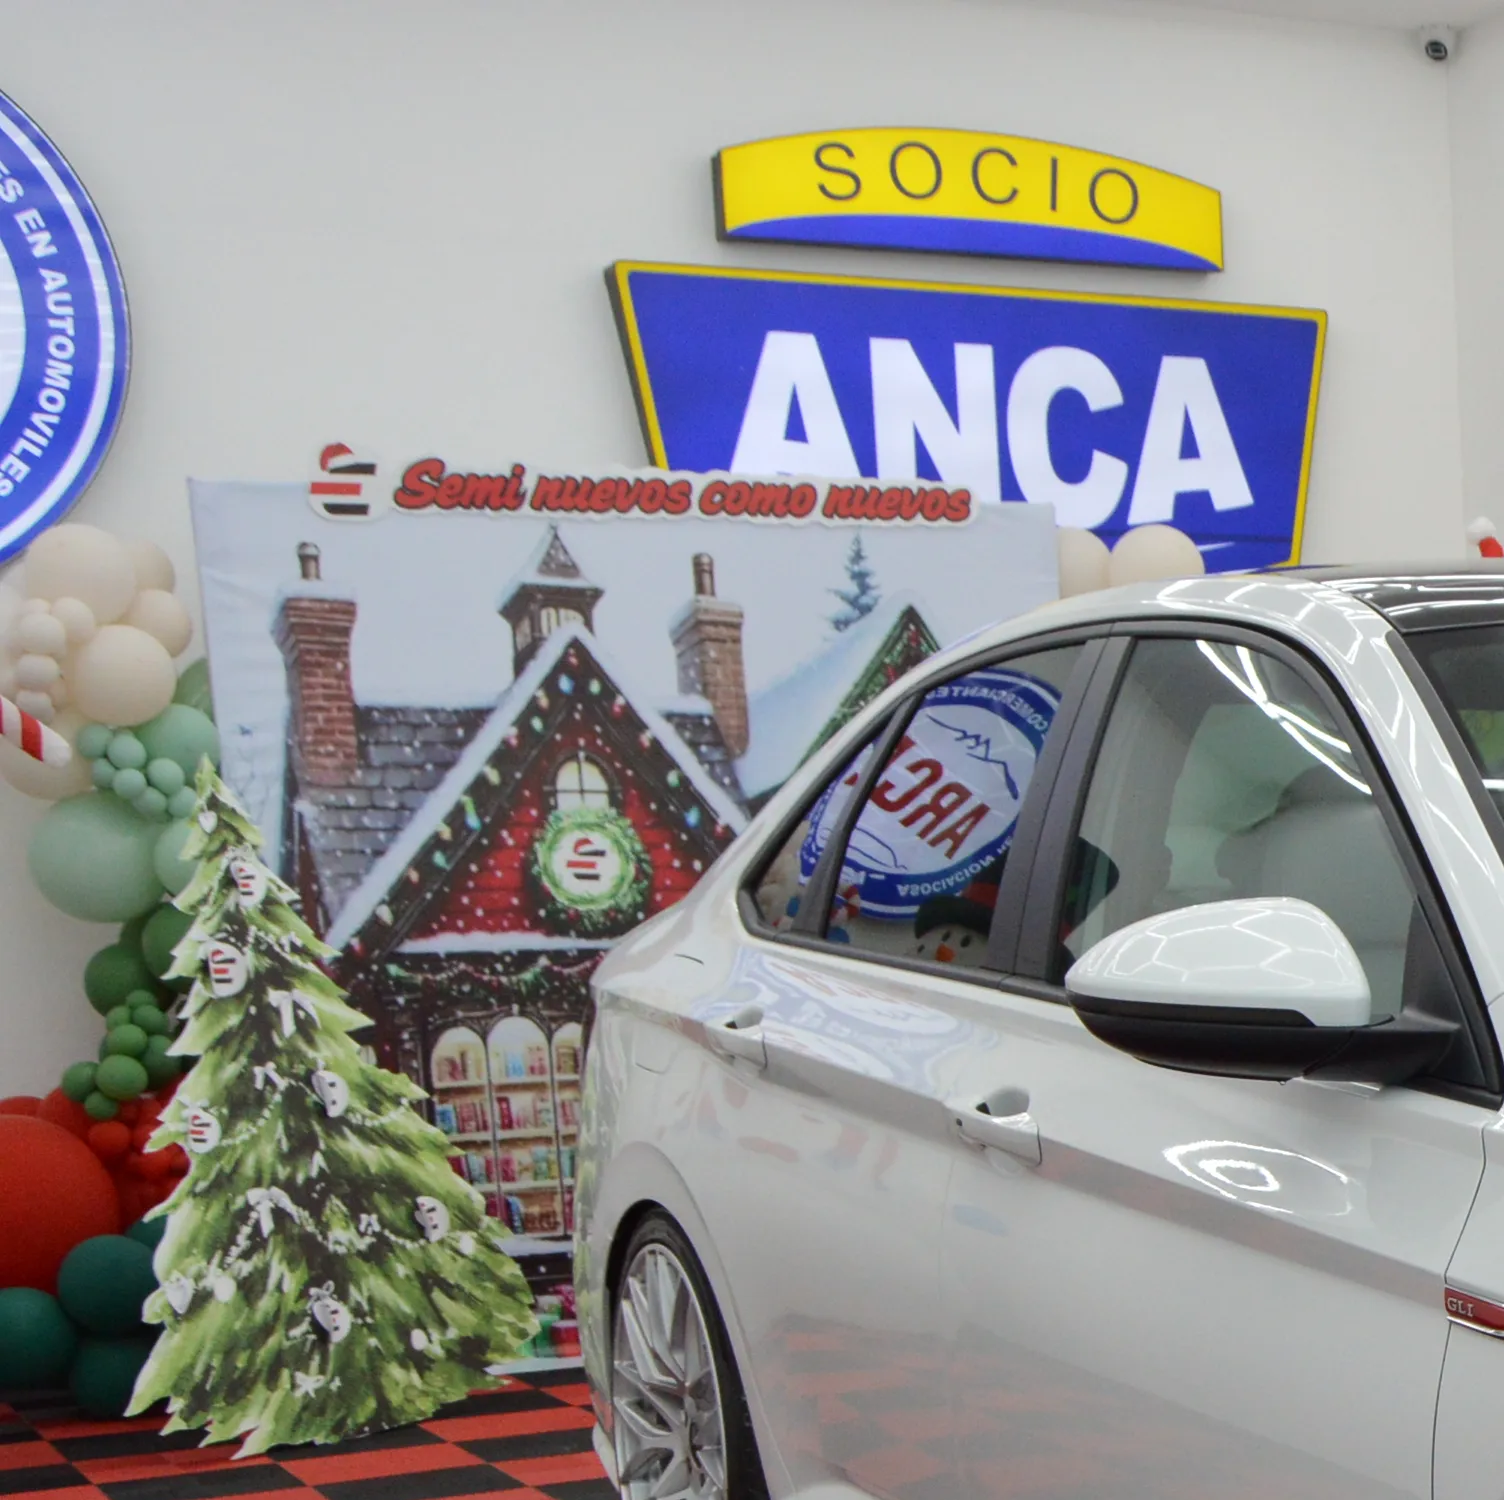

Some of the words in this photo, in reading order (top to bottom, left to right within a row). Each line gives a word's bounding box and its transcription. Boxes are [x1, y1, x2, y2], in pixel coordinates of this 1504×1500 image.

[813, 141, 1140, 225] SOCIO
[13, 207, 59, 258] EN
[728, 330, 1254, 528] ANCA
[394, 457, 527, 513] Semi
[529, 477, 692, 517] nuevos
[697, 479, 818, 519] como
[821, 482, 974, 522] nuevos
[1446, 1297, 1475, 1318] GLI
